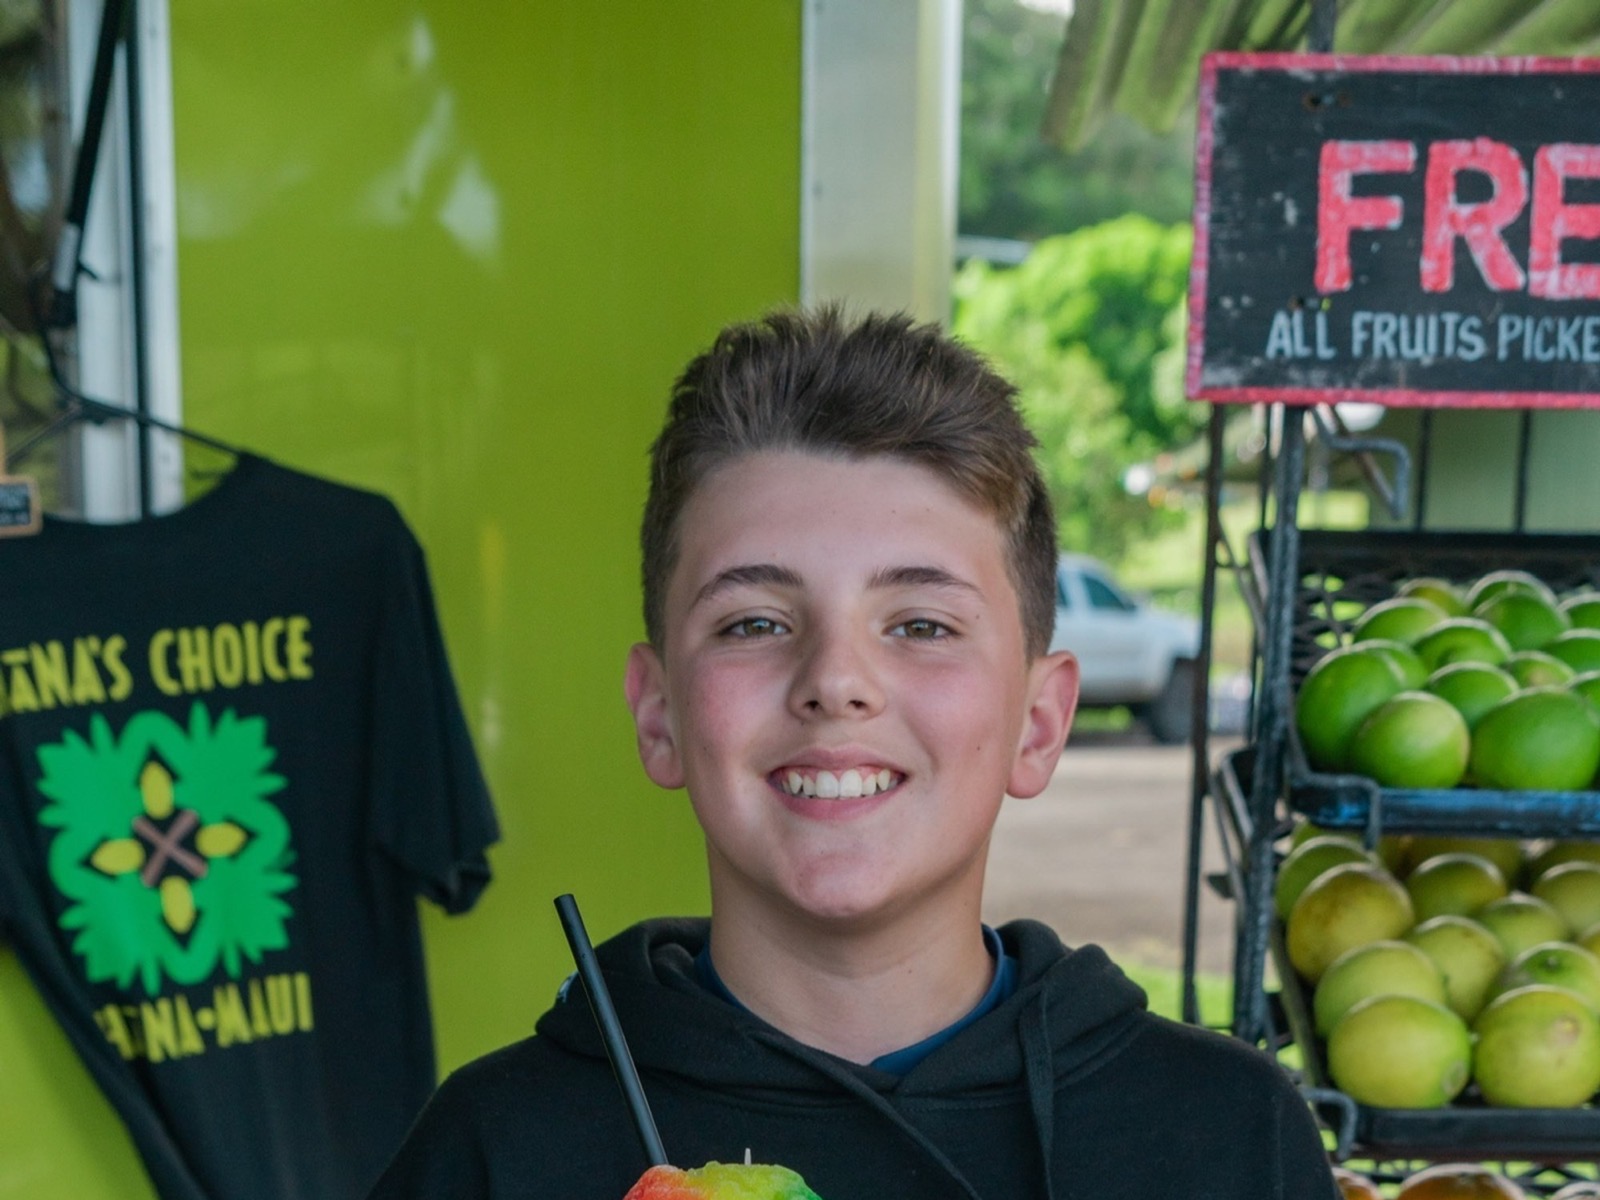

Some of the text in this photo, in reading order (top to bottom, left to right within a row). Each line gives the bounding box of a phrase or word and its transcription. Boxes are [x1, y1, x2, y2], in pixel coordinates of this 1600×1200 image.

[1266, 310, 1336, 359] ALL
[1351, 312, 1486, 362] FRUITS
[149, 616, 313, 695] CHOICE
